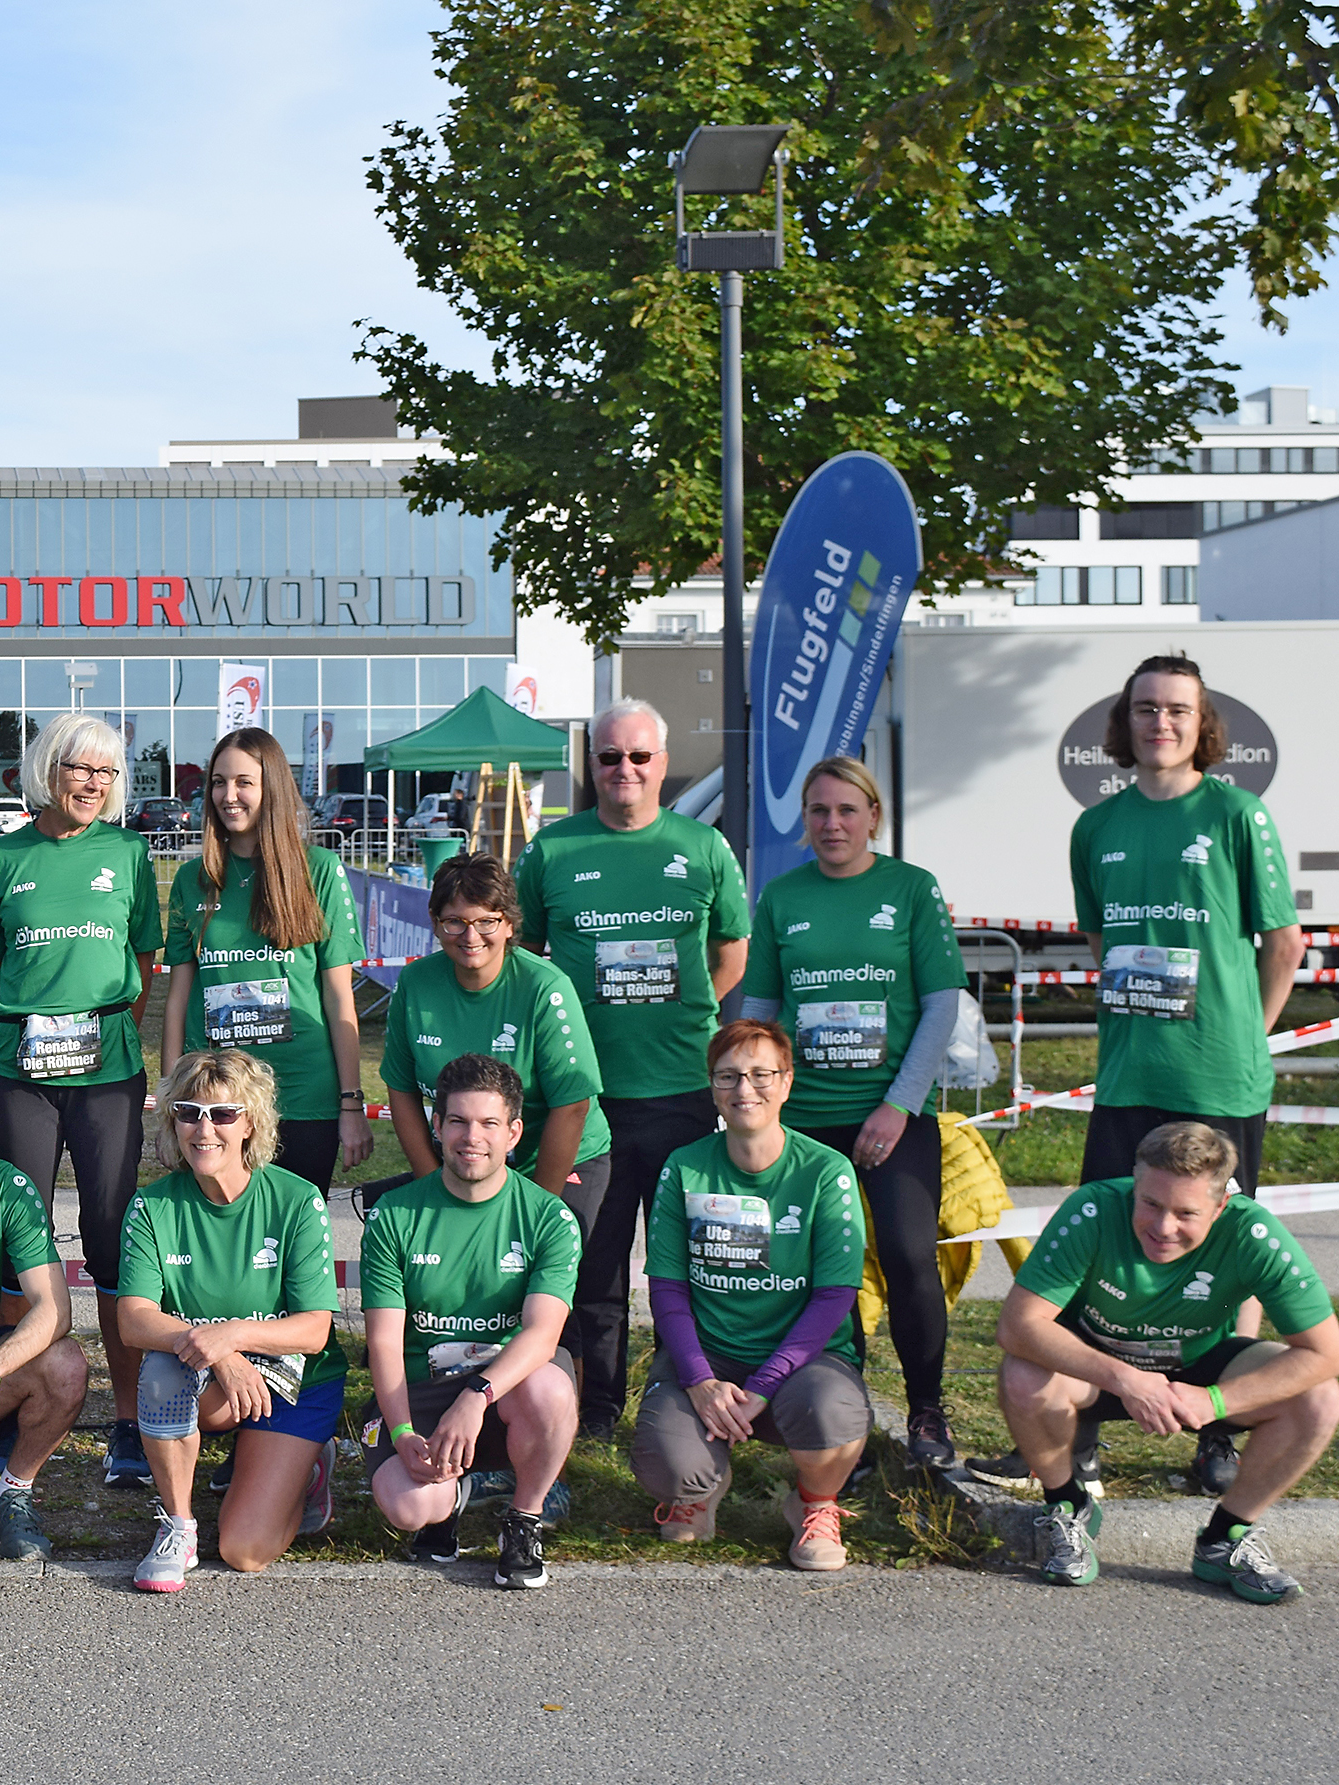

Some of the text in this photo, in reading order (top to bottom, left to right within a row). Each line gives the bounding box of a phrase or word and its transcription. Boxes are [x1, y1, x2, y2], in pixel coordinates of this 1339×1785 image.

[774, 539, 852, 731] Flugfeld
[574, 871, 601, 882] JAKO
[12, 882, 36, 894] JAKO
[574, 906, 694, 927] röhmmedien
[787, 922, 810, 934] JAKO
[605, 968, 671, 982] Hans-Jörg
[791, 963, 896, 985] röhmmedien
[602, 982, 675, 996] Die Röhmer
[1127, 975, 1162, 991] Luca
[262, 994, 286, 1005] 1041
[1103, 990, 1187, 1011] Die Röhmer
[232, 1010, 259, 1022] Ines
[211, 1024, 284, 1041] Die Röhmer
[820, 1030, 862, 1045] Nicole
[35, 1040, 80, 1054] Renate
[417, 1034, 442, 1046] JAKO
[804, 1047, 881, 1061] Die Röhmer
[22, 1053, 95, 1070] Die Röhmer
[706, 1225, 731, 1241] Ute
[704, 1242, 761, 1260] Röhmer
[166, 1254, 192, 1265] JAKO
[412, 1254, 440, 1264] JAKO
[1097, 1279, 1127, 1300] JAKO
